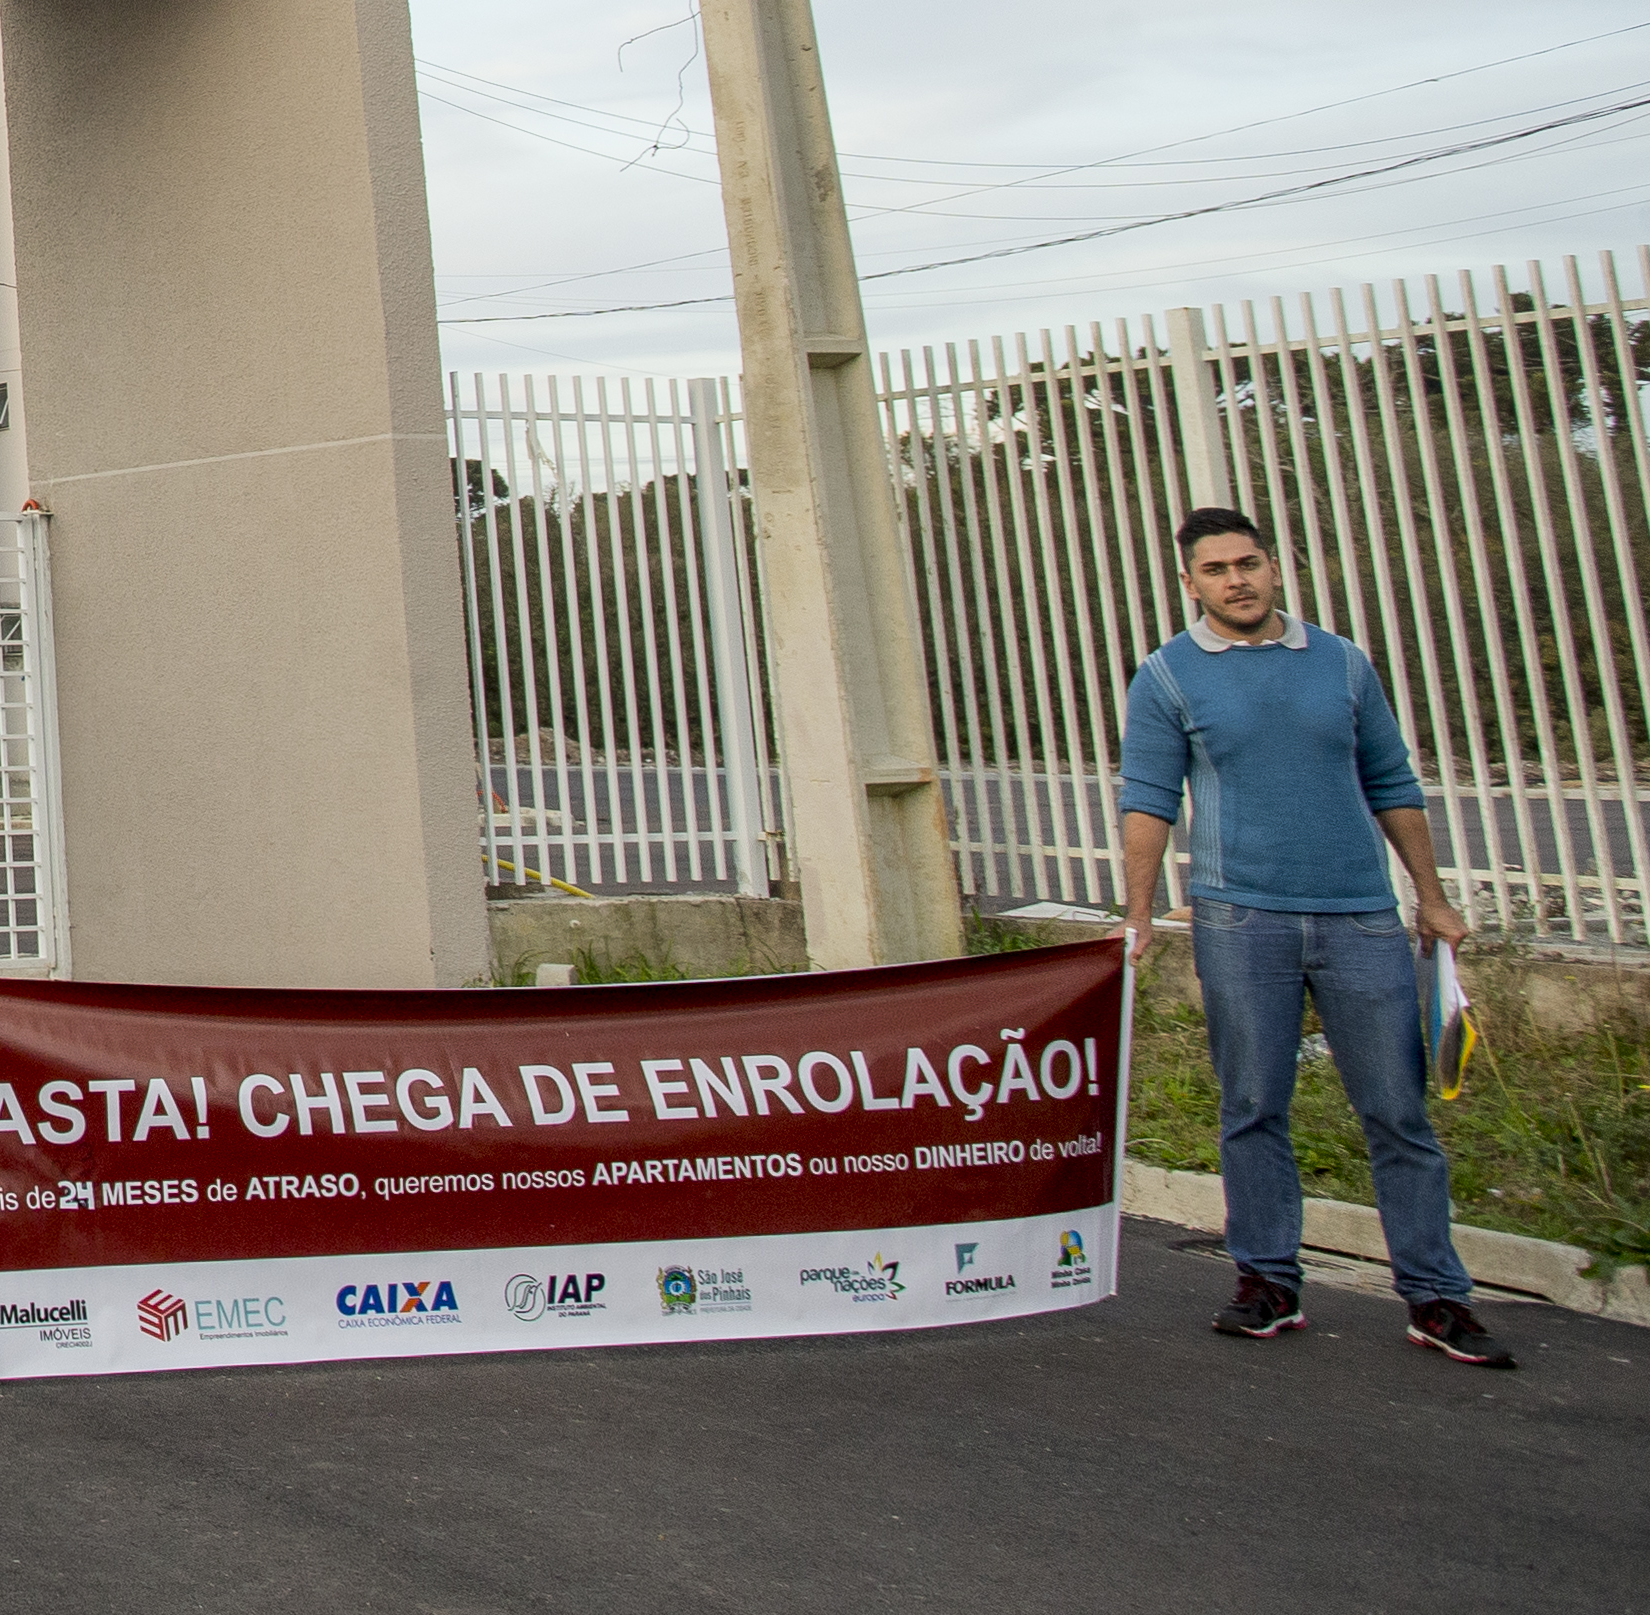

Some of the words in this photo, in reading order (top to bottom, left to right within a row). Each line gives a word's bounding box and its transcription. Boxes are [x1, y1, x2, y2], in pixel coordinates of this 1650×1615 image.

[238, 1067, 513, 1138] CHEGA
[520, 1063, 629, 1126] DE
[640, 1028, 1100, 1122] ENROLAÇÃO!
[25, 1186, 57, 1211] de
[58, 1181, 96, 1211] 24
[103, 1179, 200, 1207] MESES
[206, 1179, 238, 1203] de
[245, 1173, 367, 1202] ATRASO,
[374, 1172, 494, 1201] queremos
[502, 1167, 586, 1190] nossos
[592, 1153, 803, 1186] APARTAMENTOS
[808, 1157, 839, 1175] ou
[843, 1151, 909, 1173] nosso
[915, 1141, 1025, 1170] DINHEIRO
[1029, 1139, 1054, 1162] de
[1057, 1131, 1102, 1157] volta!
[336, 1281, 459, 1316] CAIXA
[547, 1273, 606, 1304] IAP
[945, 1274, 1016, 1296] FORMULA
[195, 1296, 287, 1331] EMEC
[338, 1319, 366, 1330] CAIXA
[368, 1316, 424, 1328] ECONÔMICA
[426, 1313, 462, 1325] FEDERAL
